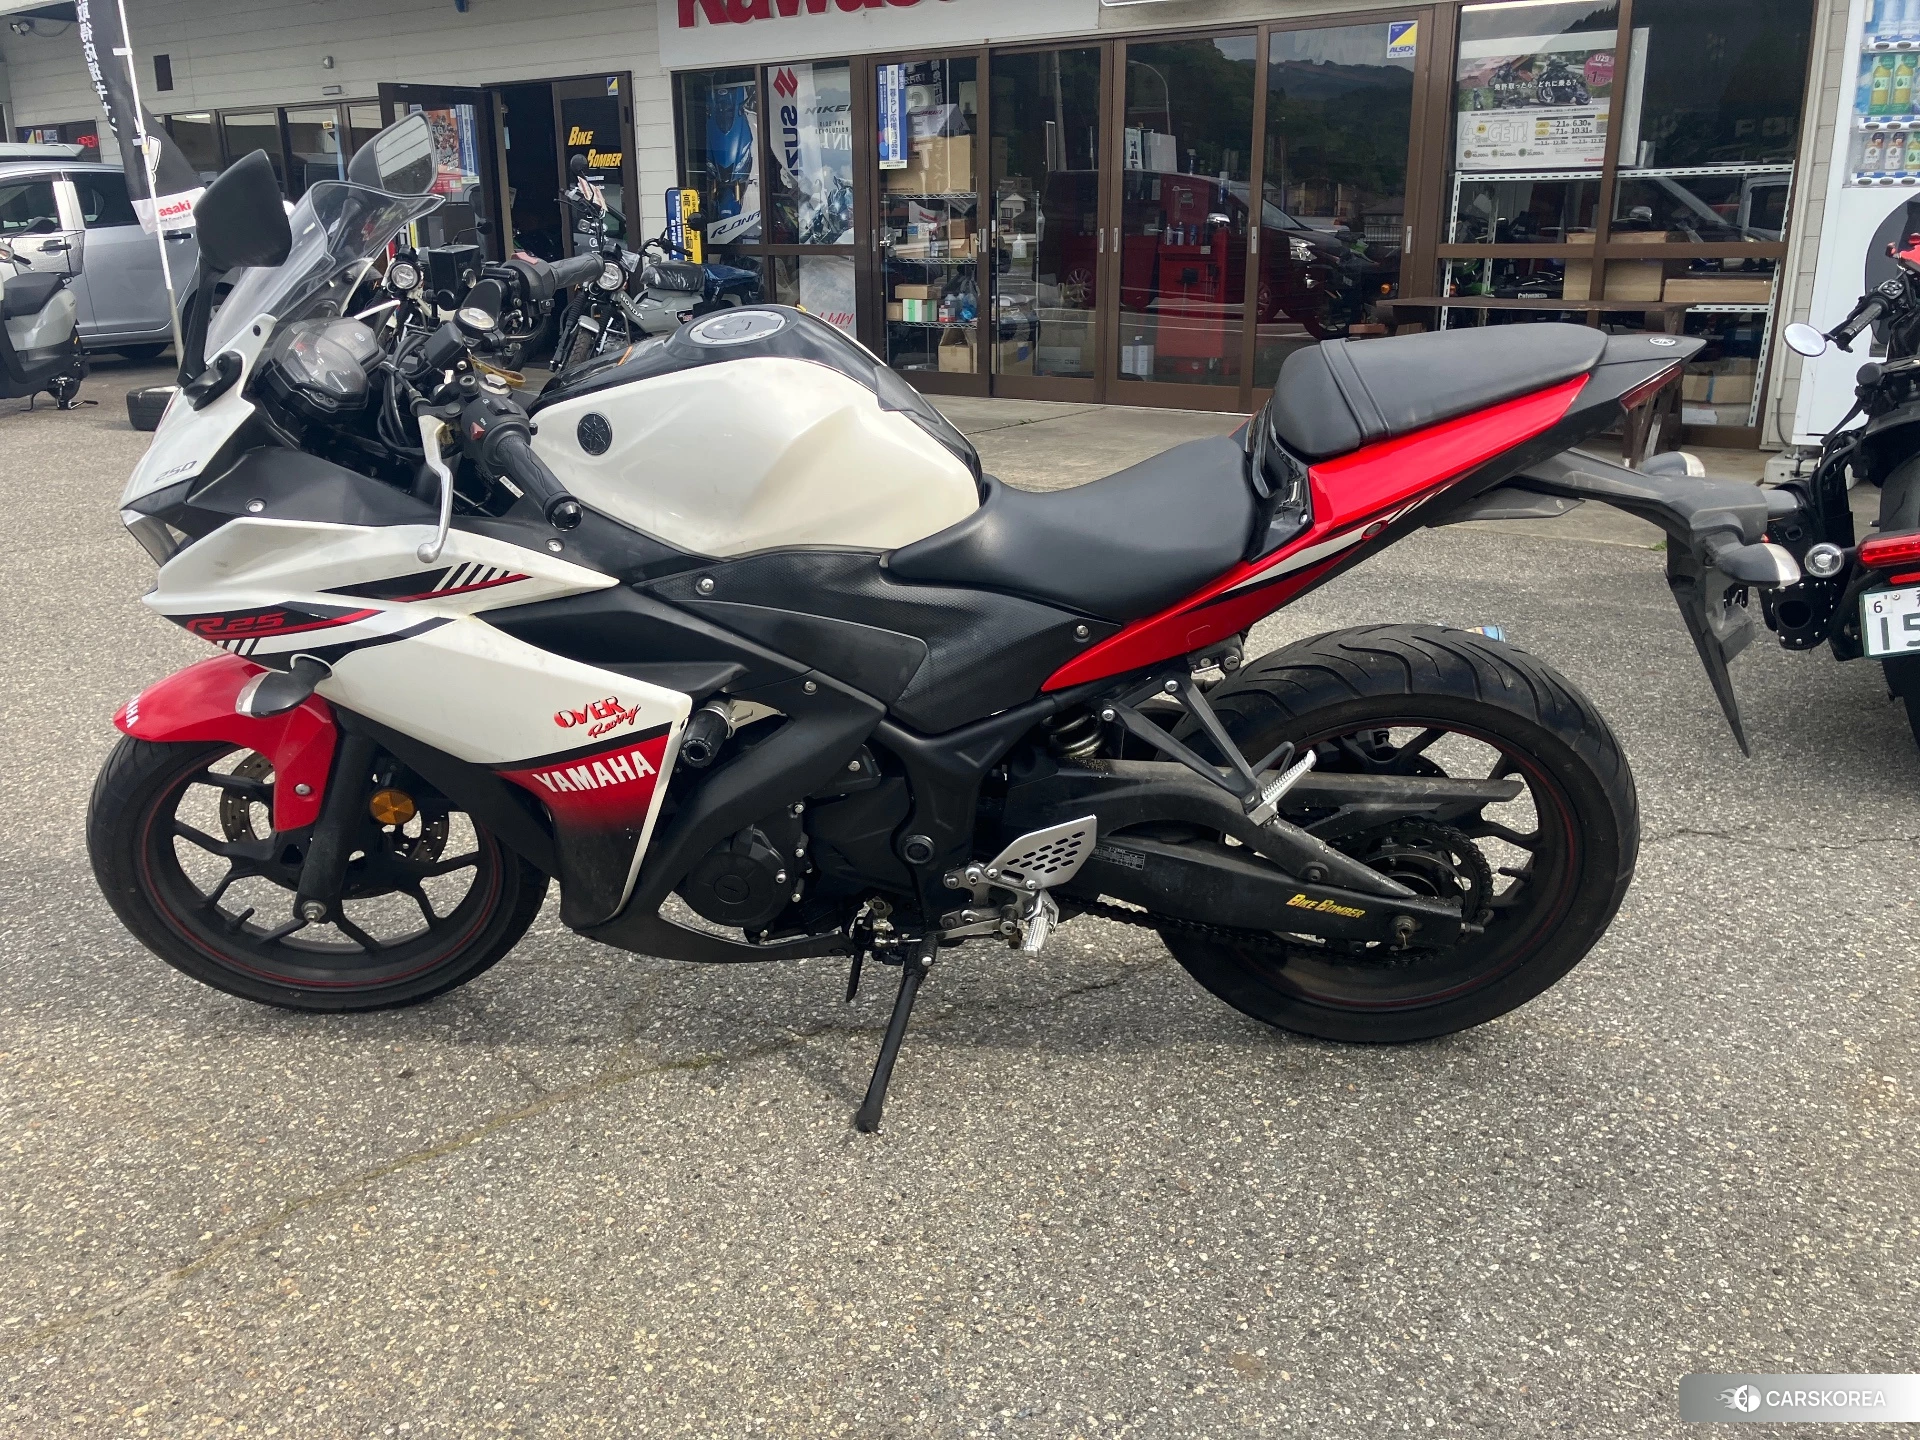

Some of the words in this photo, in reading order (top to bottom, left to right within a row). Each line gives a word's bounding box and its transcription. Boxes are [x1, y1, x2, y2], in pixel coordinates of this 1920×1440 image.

[158, 199, 192, 217] asaki
[620, 293, 645, 320] HONDA
[154, 460, 197, 484] 250
[1873, 600, 1883, 614] 6
[186, 611, 288, 633] R25
[553, 696, 626, 728] OVER
[587, 704, 641, 739] Racing
[532, 750, 656, 793] YAMAHA
